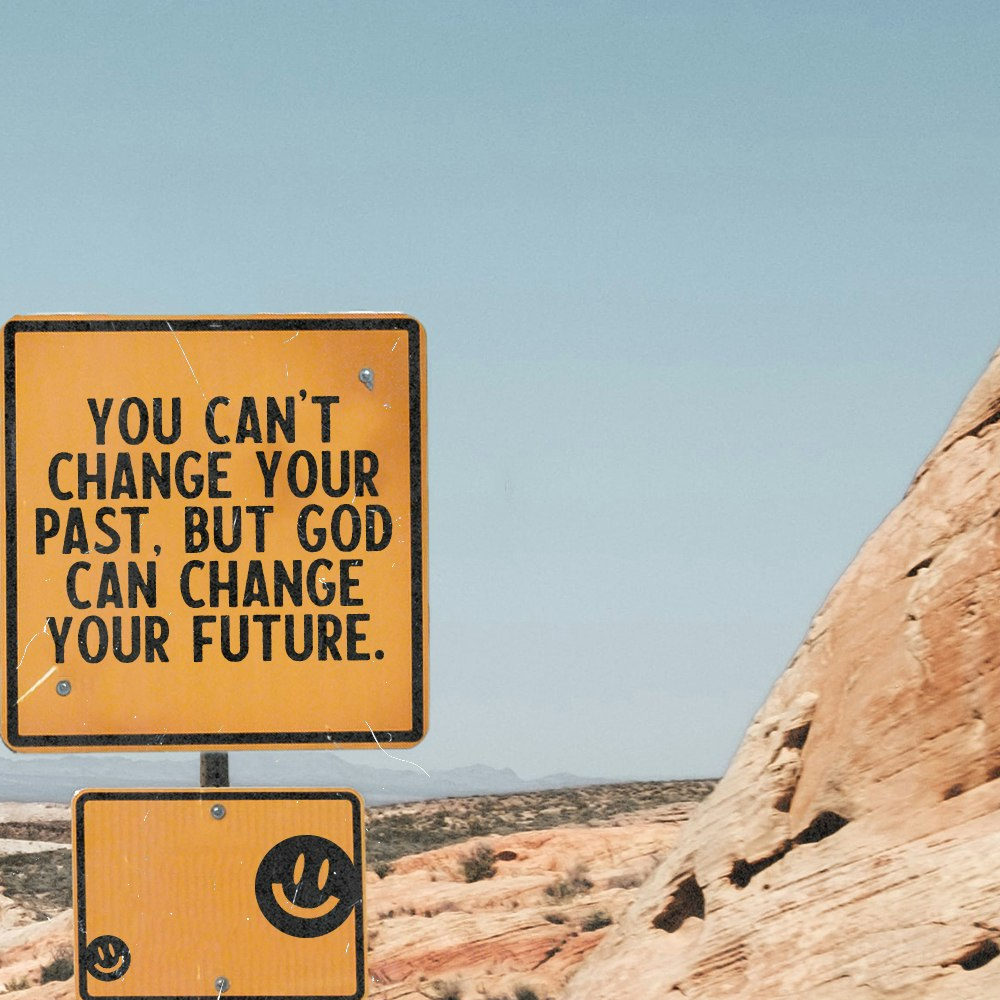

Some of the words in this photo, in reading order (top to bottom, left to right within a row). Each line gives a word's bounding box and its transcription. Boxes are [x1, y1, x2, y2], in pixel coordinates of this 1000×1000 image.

[87, 397, 181, 445] YOU
[205, 390, 339, 444] CAN'T
[49, 451, 232, 500] CHANGE
[256, 450, 379, 498] YOUR
[36, 507, 161, 556] PAST,
[185, 506, 273, 553] BUT
[297, 504, 392, 552] GOD
[67, 561, 156, 609] CAN
[180, 558, 363, 608] CHANGE
[47, 616, 169, 663] YOUR
[193, 614, 384, 662] FUTURE.
